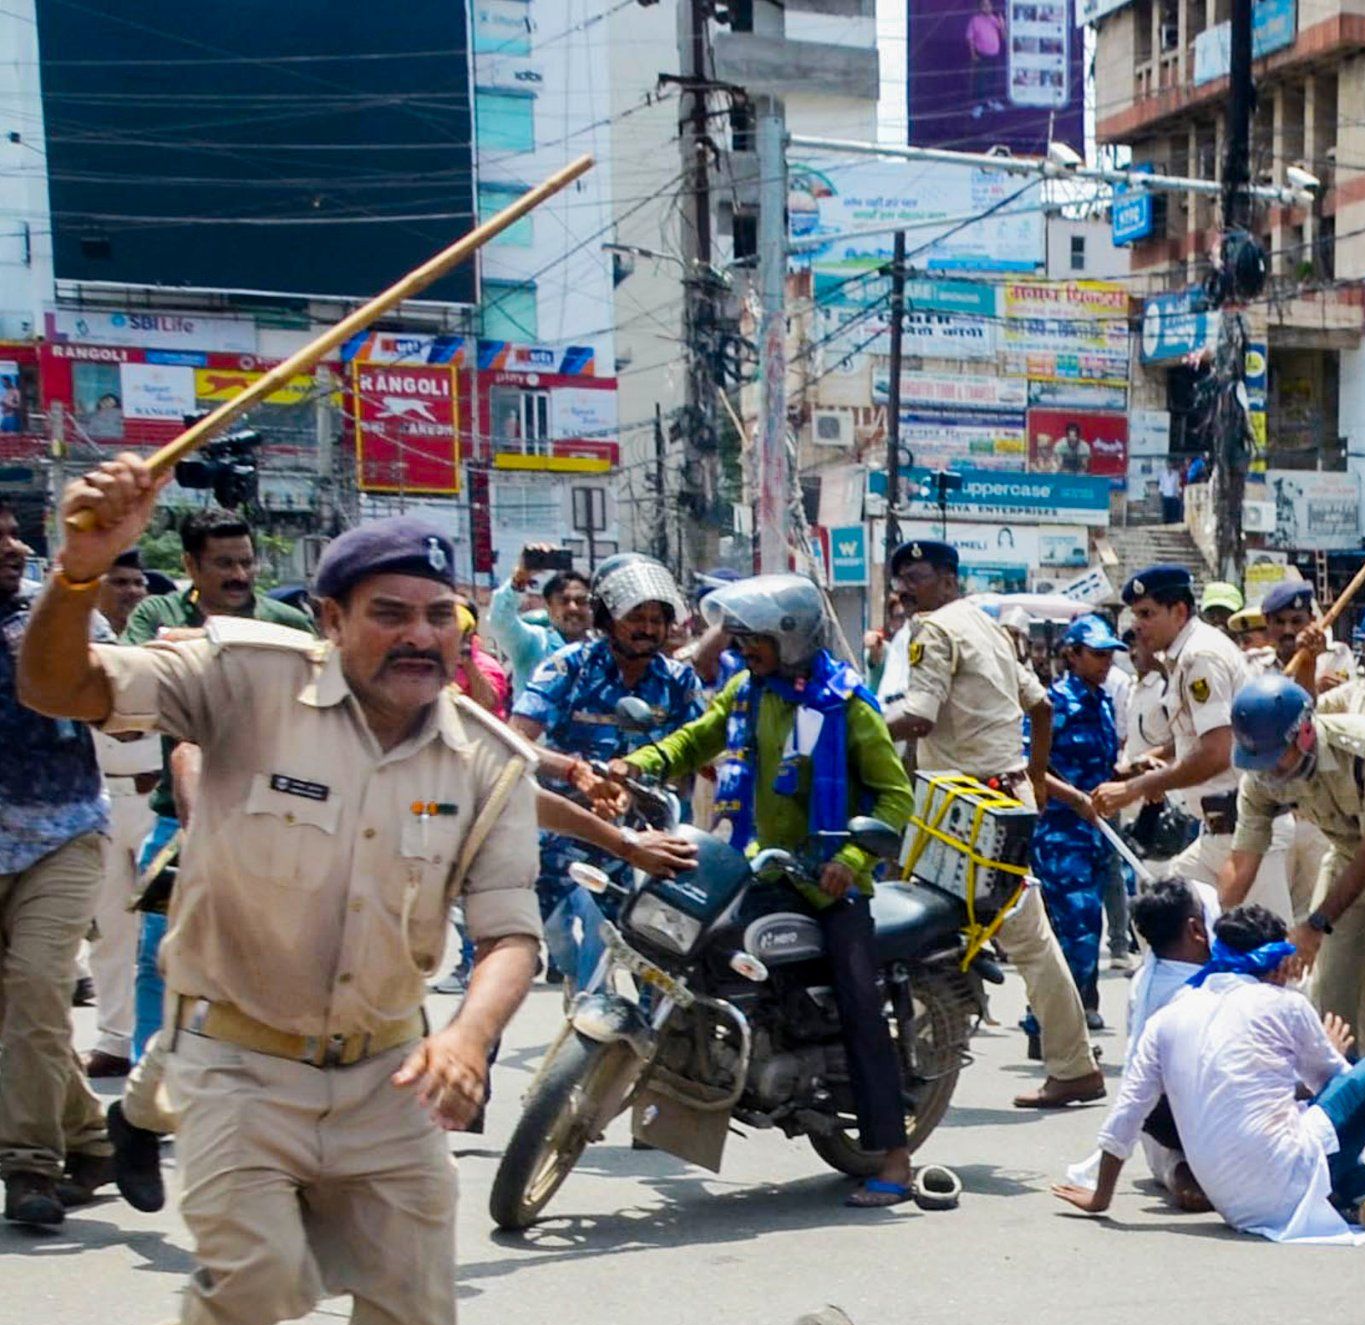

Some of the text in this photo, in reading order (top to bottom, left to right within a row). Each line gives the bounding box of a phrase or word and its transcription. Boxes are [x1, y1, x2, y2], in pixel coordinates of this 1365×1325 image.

[52, 344, 127, 361] RANGOLI
[360, 375, 449, 396] RANGOLI
[962, 480, 1050, 499] uppercase
[978, 504, 1058, 518] ENTERPRISES
